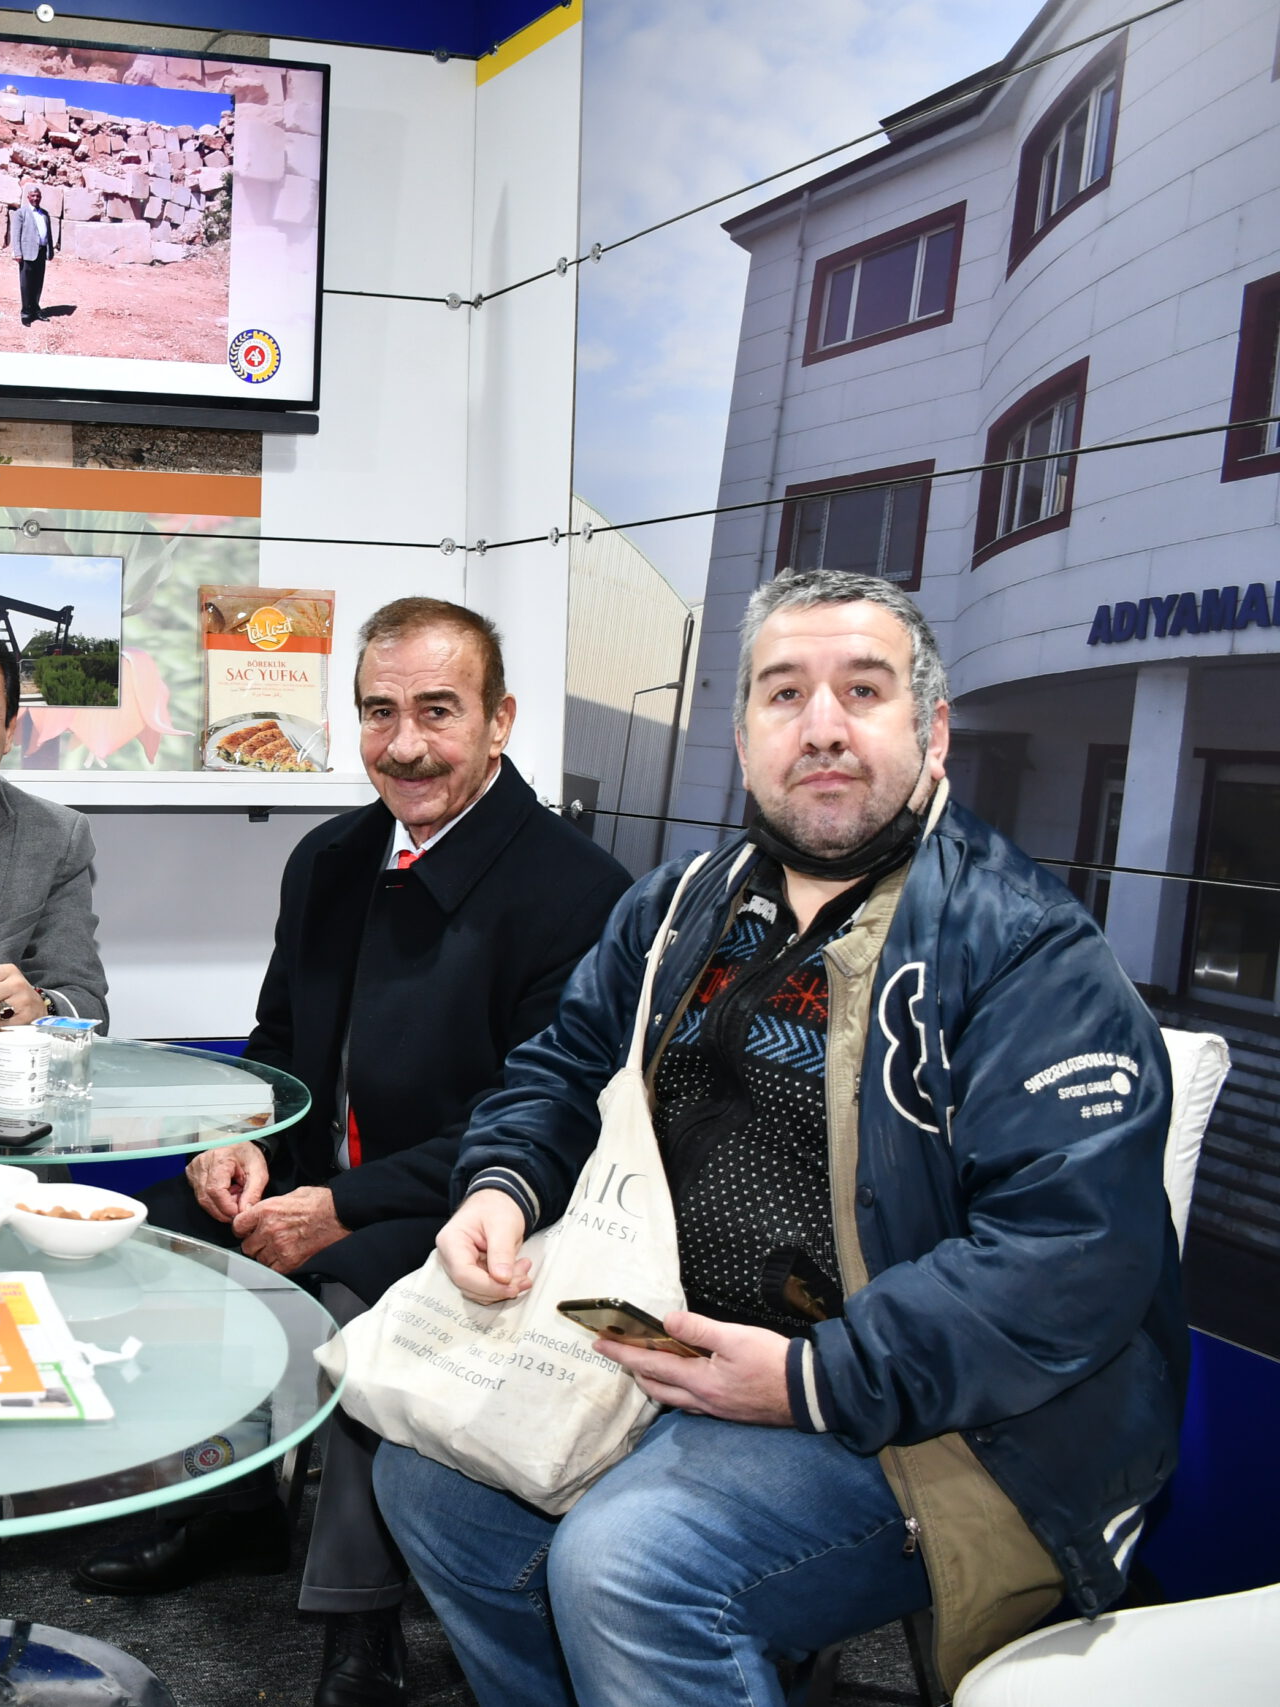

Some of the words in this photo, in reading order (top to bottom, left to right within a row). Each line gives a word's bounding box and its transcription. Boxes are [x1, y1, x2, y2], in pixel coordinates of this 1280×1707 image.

[1087, 580, 1280, 645] ADIYAMA
[226, 668, 254, 682] SAC
[258, 669, 309, 682] YUFKA
